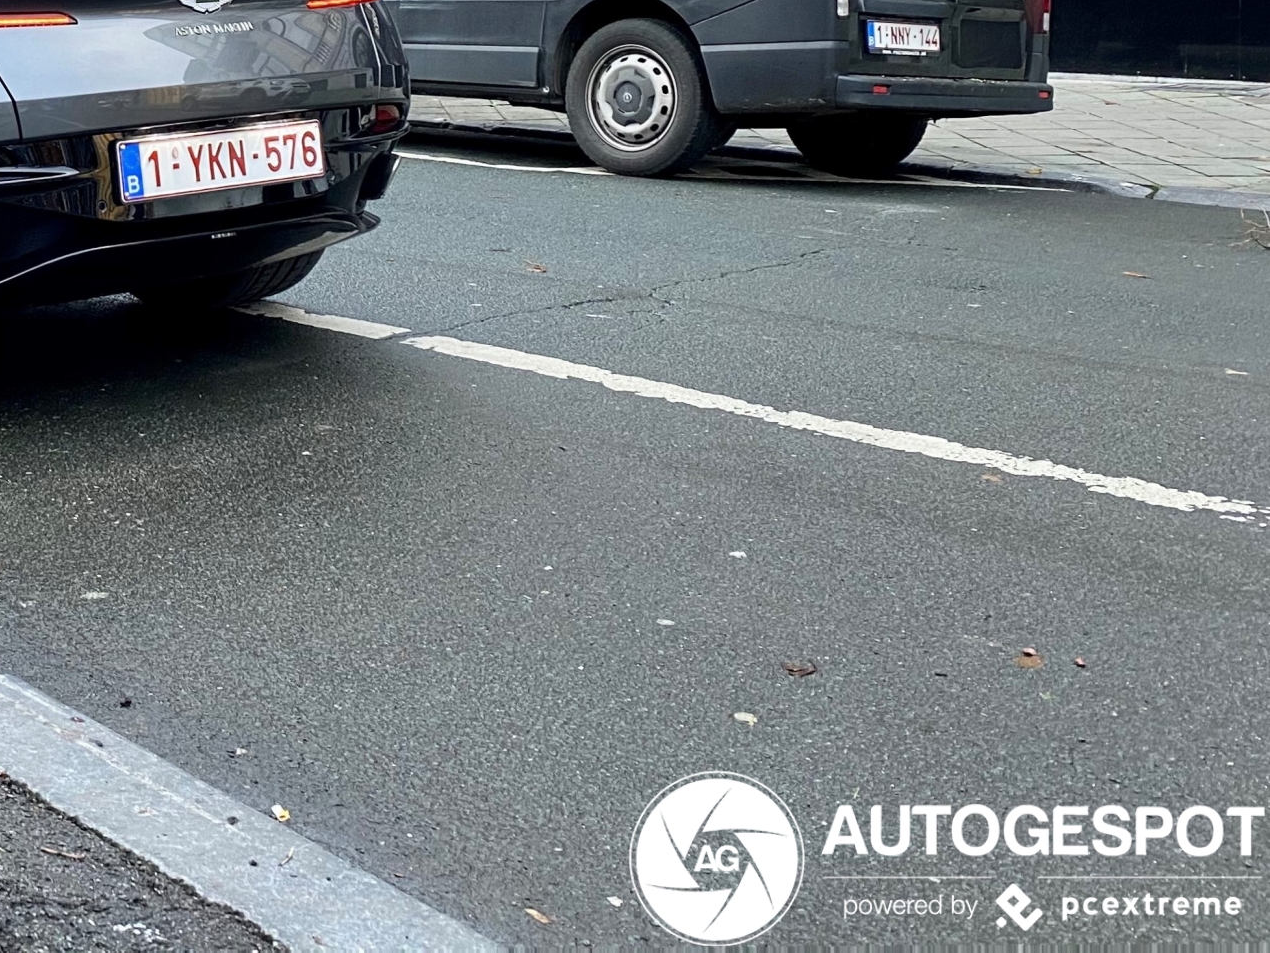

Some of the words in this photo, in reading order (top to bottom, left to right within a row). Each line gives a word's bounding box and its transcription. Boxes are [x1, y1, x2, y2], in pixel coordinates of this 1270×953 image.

[176, 24, 211, 36] ASTON
[148, 131, 318, 187] 1-YKN-576
[127, 175, 140, 194] B
